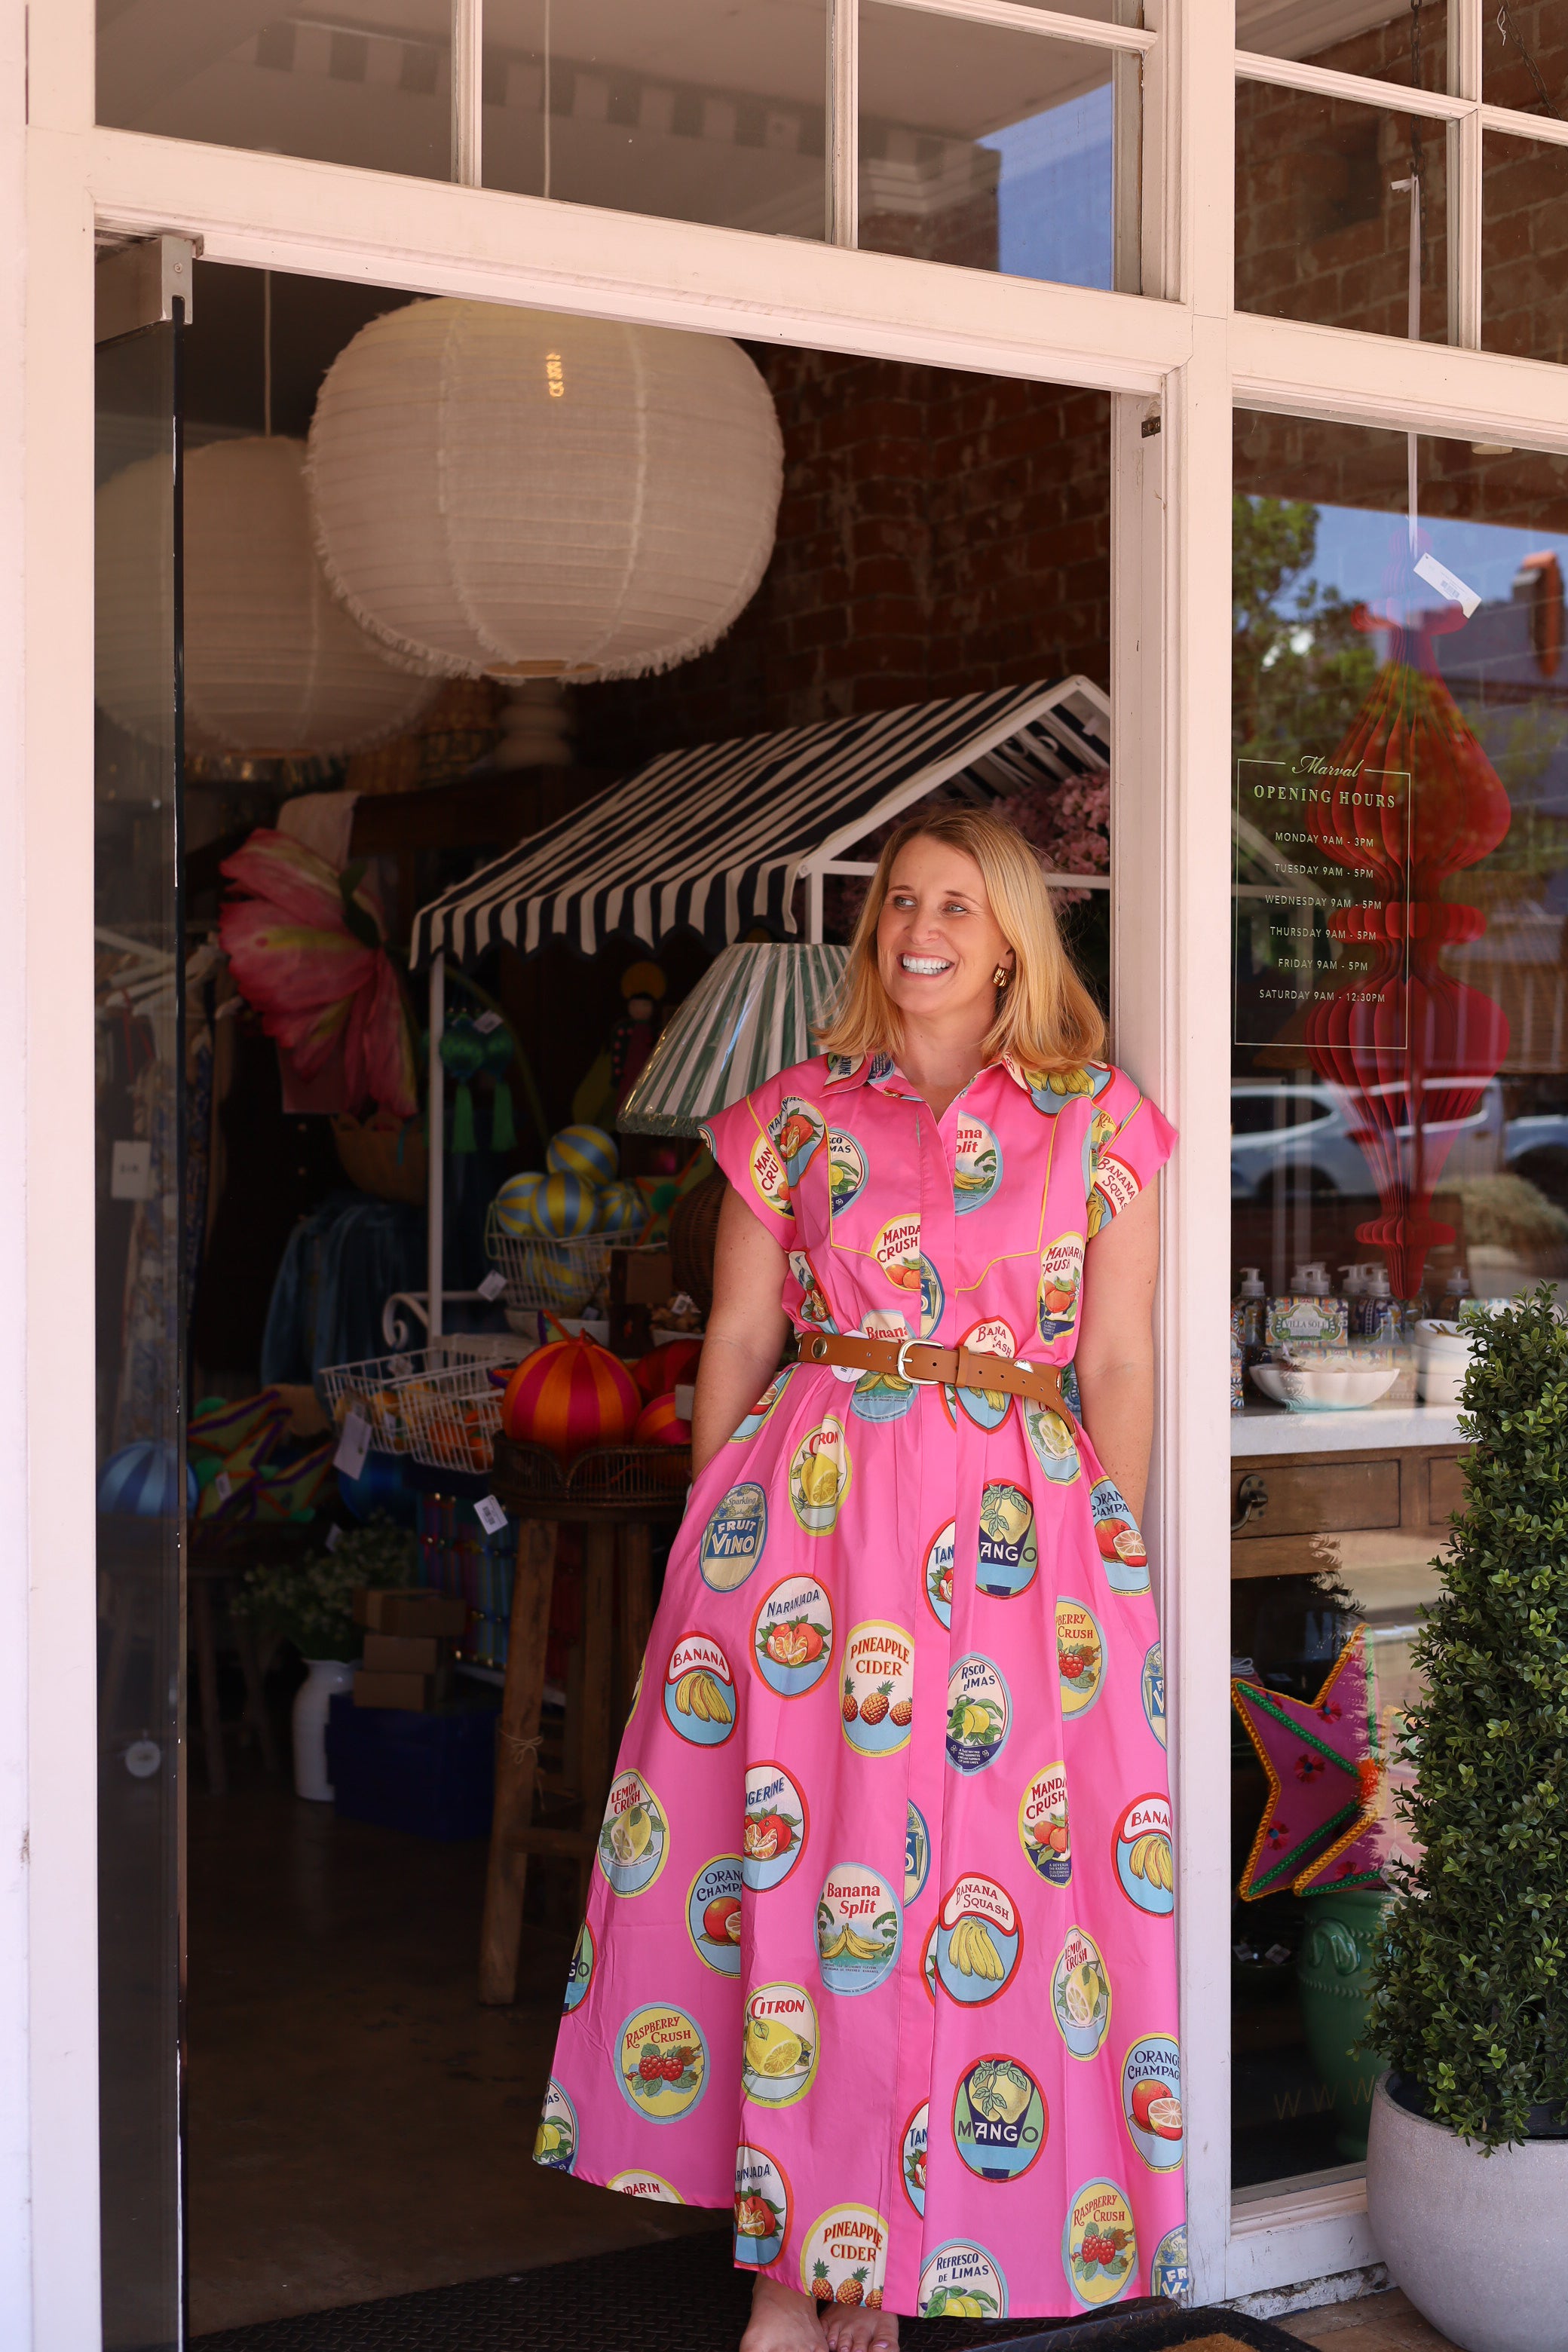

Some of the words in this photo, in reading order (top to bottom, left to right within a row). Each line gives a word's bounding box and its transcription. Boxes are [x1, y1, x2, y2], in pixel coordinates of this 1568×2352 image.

[1291, 755, 1364, 778] Marval
[1254, 785, 1331, 804] OPENING
[1339, 791, 1395, 808] HOURS
[1275, 831, 1319, 844] MONDAY
[1322, 835, 1343, 846] 9AM
[1354, 838, 1374, 847] 3PM
[1275, 863, 1319, 876] TUESDAY
[1322, 866, 1343, 877] 9AM
[1354, 868, 1374, 878] 5PM
[1265, 895, 1327, 908] WEDNESDAY
[1331, 898, 1352, 908] 9AM
[1362, 900, 1382, 910] 5PM
[1269, 926, 1321, 939] THURSDAY
[1325, 929, 1346, 939] 9AM
[1357, 931, 1377, 941] 5PM
[1278, 958, 1313, 969] FRIDAY
[1316, 960, 1337, 970] 9AM
[1348, 961, 1368, 972] 5PM
[1259, 989, 1310, 1000] SATURDAY
[1314, 991, 1334, 1001] 9AM
[1346, 992, 1386, 1003] 12:30PM
[761, 1158, 779, 1191] CRU
[1097, 1157, 1136, 1200] BANANA
[877, 1236, 918, 1263] CRUSH
[1284, 1319, 1306, 1329] VILLA
[727, 1496, 756, 1507] Sparkling
[717, 1518, 756, 1535] FRUIT
[712, 1533, 755, 1555] VINO
[1058, 1625, 1093, 1639] CRUSH
[673, 1648, 727, 1673] BANANA
[850, 1636, 910, 1665] PINEAPPLE
[856, 1659, 903, 1677] CIDER
[611, 1781, 638, 1804] LEMON
[745, 1776, 785, 1807] GERINE
[614, 1790, 641, 1815] CRUSH
[1026, 1790, 1066, 1820] CRUSH
[1132, 1811, 1171, 1827] BANA
[826, 1882, 880, 1898] Banana
[955, 1883, 999, 1906] BANANA
[839, 1900, 877, 1919] Split
[963, 1894, 1009, 1921] SQUASH
[1066, 1948, 1088, 1973] CRUSH
[751, 1996, 805, 2020] CITRON
[625, 2016, 681, 2050] RASPBERRY
[651, 2029, 692, 2044] CRUSH
[958, 2120, 1039, 2143] MANGO
[1073, 2194, 1118, 2227] RASPBERRY
[1093, 2210, 1125, 2222] CRUSH
[830, 2243, 877, 2262] CIDER
[936, 2252, 979, 2271] REFRESCO
[938, 2272, 948, 2283] DE
[951, 2264, 989, 2280] LIMAS
